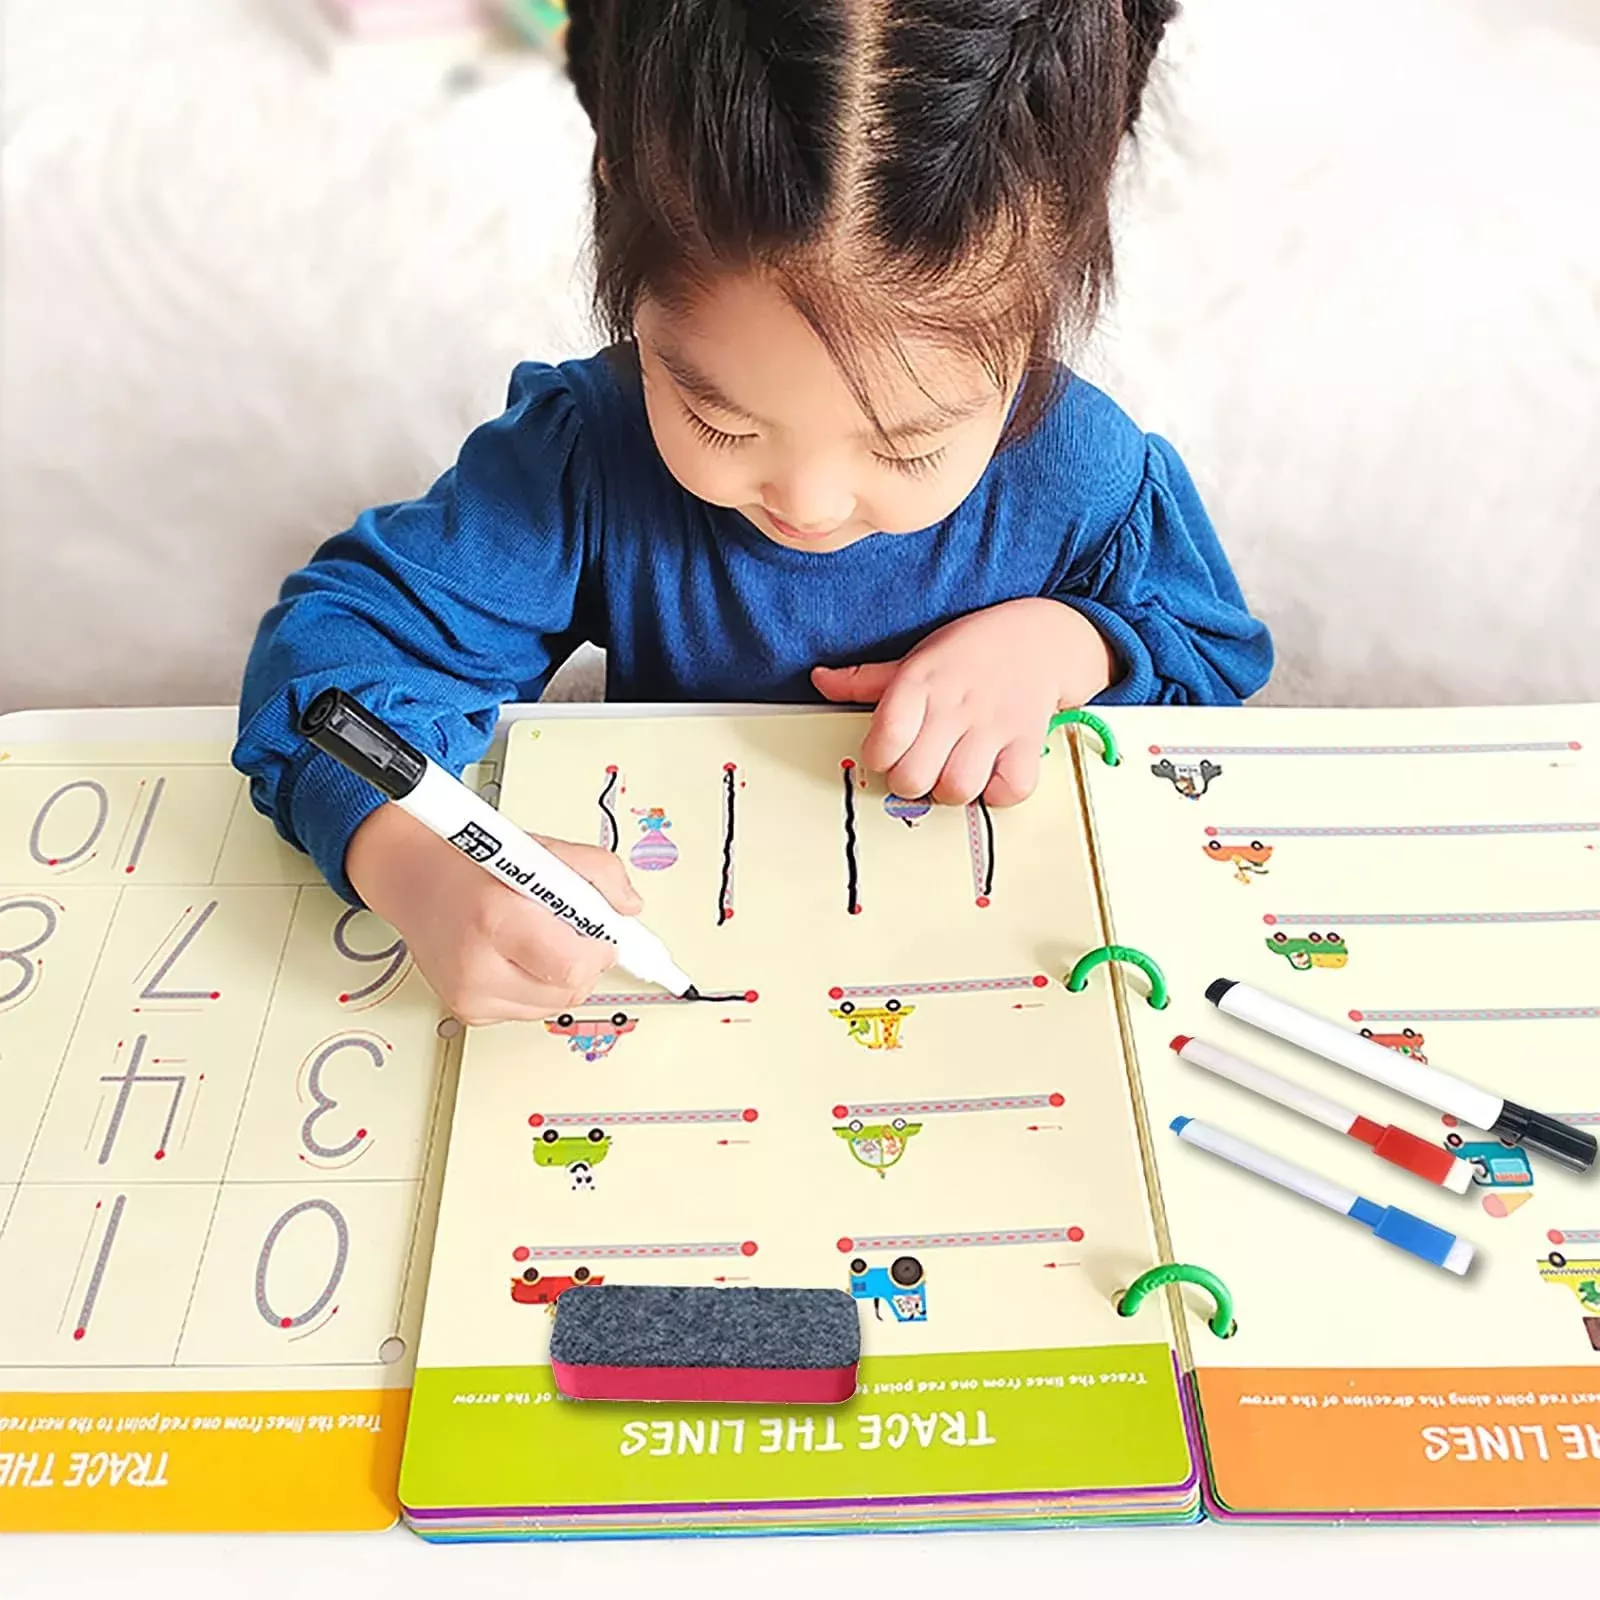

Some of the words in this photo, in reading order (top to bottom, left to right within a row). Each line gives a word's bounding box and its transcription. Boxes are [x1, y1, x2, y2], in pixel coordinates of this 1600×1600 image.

[495, 857, 536, 886] pen
[530, 883, 618, 944] ipe-clean
[139, 901, 220, 999] 7
[98, 1034, 186, 1165] 4
[302, 1037, 384, 1158] 3
[73, 1194, 127, 1340] 1
[255, 1199, 349, 1328] 0
[874, 1379, 913, 1393] point
[918, 1379, 945, 1392] red
[951, 1379, 978, 1390] one
[984, 1377, 1021, 1390] from
[1069, 1374, 1095, 1386] the
[1100, 1372, 1147, 1385] Trace
[453, 1392, 500, 1404] arrow
[505, 1393, 530, 1405] the
[534, 1392, 552, 1405] of
[1239, 1394, 1287, 1406] arrow
[1291, 1395, 1318, 1408] the
[1322, 1394, 1339, 1408] of
[1342, 1394, 1415, 1408] direction
[1418, 1395, 1446, 1408] the
[1448, 1392, 1491, 1408] along
[1496, 1392, 1535, 1406] point
[1539, 1393, 1568, 1406] red
[28, 1416, 65, 1433] next
[67, 1415, 93, 1433] the
[96, 1416, 114, 1432] to
[116, 1412, 160, 1433] point
[160, 1416, 190, 1433] red
[192, 1415, 223, 1430] one
[224, 1415, 263, 1433] from
[266, 1415, 305, 1433] lines
[308, 1415, 334, 1432] the
[337, 1414, 381, 1433] Trace
[857, 1410, 996, 1450] TRACE
[620, 1419, 745, 1456] LINES
[759, 1416, 844, 1453] THE
[1421, 1425, 1550, 1461] LINES
[0, 1451, 55, 1487] THE
[64, 1451, 169, 1487] TRACE
